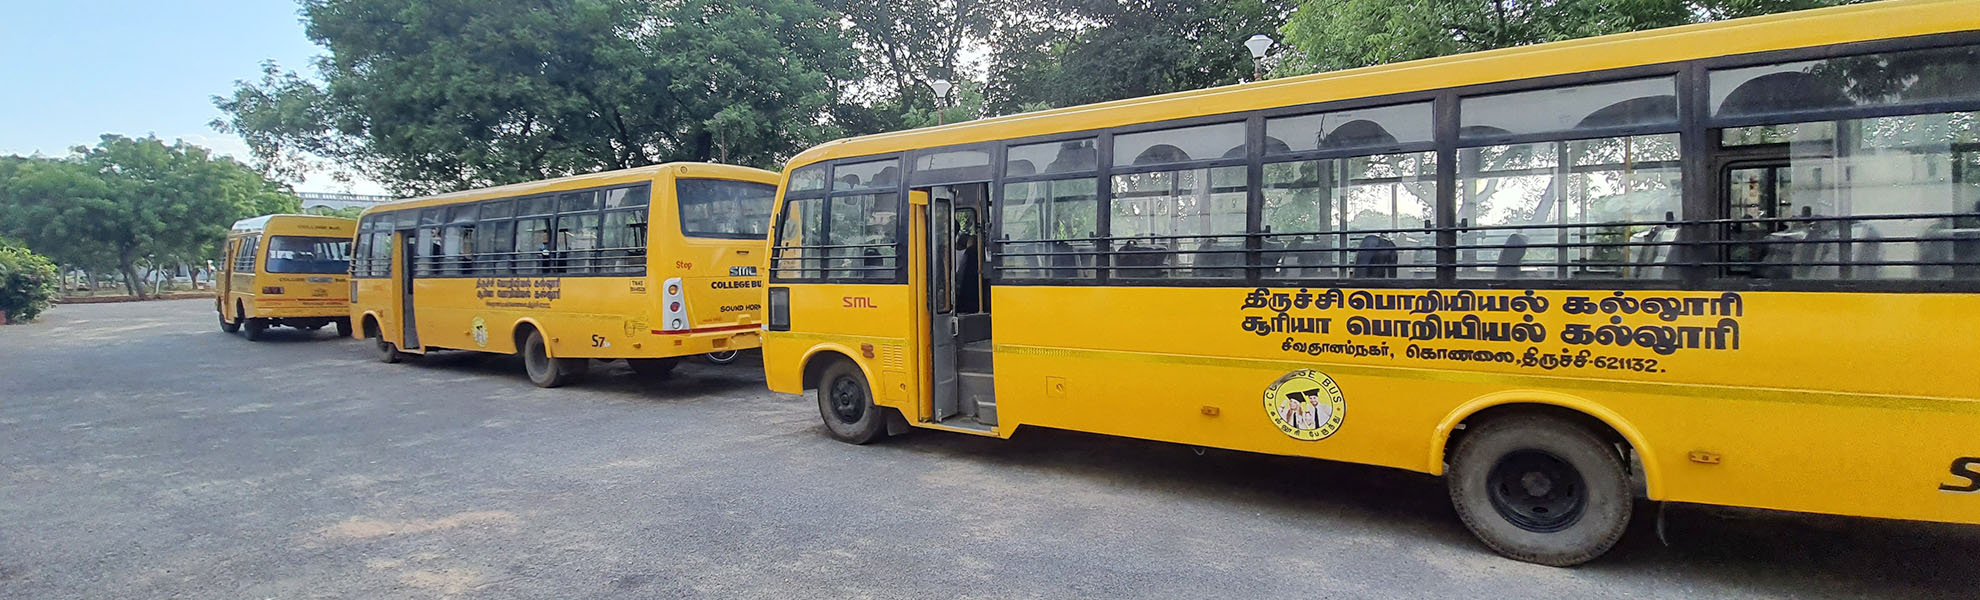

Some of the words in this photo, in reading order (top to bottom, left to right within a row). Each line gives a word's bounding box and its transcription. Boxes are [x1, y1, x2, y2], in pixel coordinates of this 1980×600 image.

[676, 260, 693, 271] Stop
[729, 265, 758, 277] SML
[711, 281, 750, 290] COLLEGE
[751, 280, 762, 288] BU
[720, 304, 744, 313] SOUND
[842, 296, 878, 309] SML
[1562, 289, 1744, 322] கல்லூரி
[1241, 312, 1332, 336] சூரியா
[1346, 314, 1547, 344] பொறியியல்
[1560, 315, 1741, 356] கல்லூரி
[592, 334, 606, 348] S7
[1322, 378, 1343, 403] BUS
